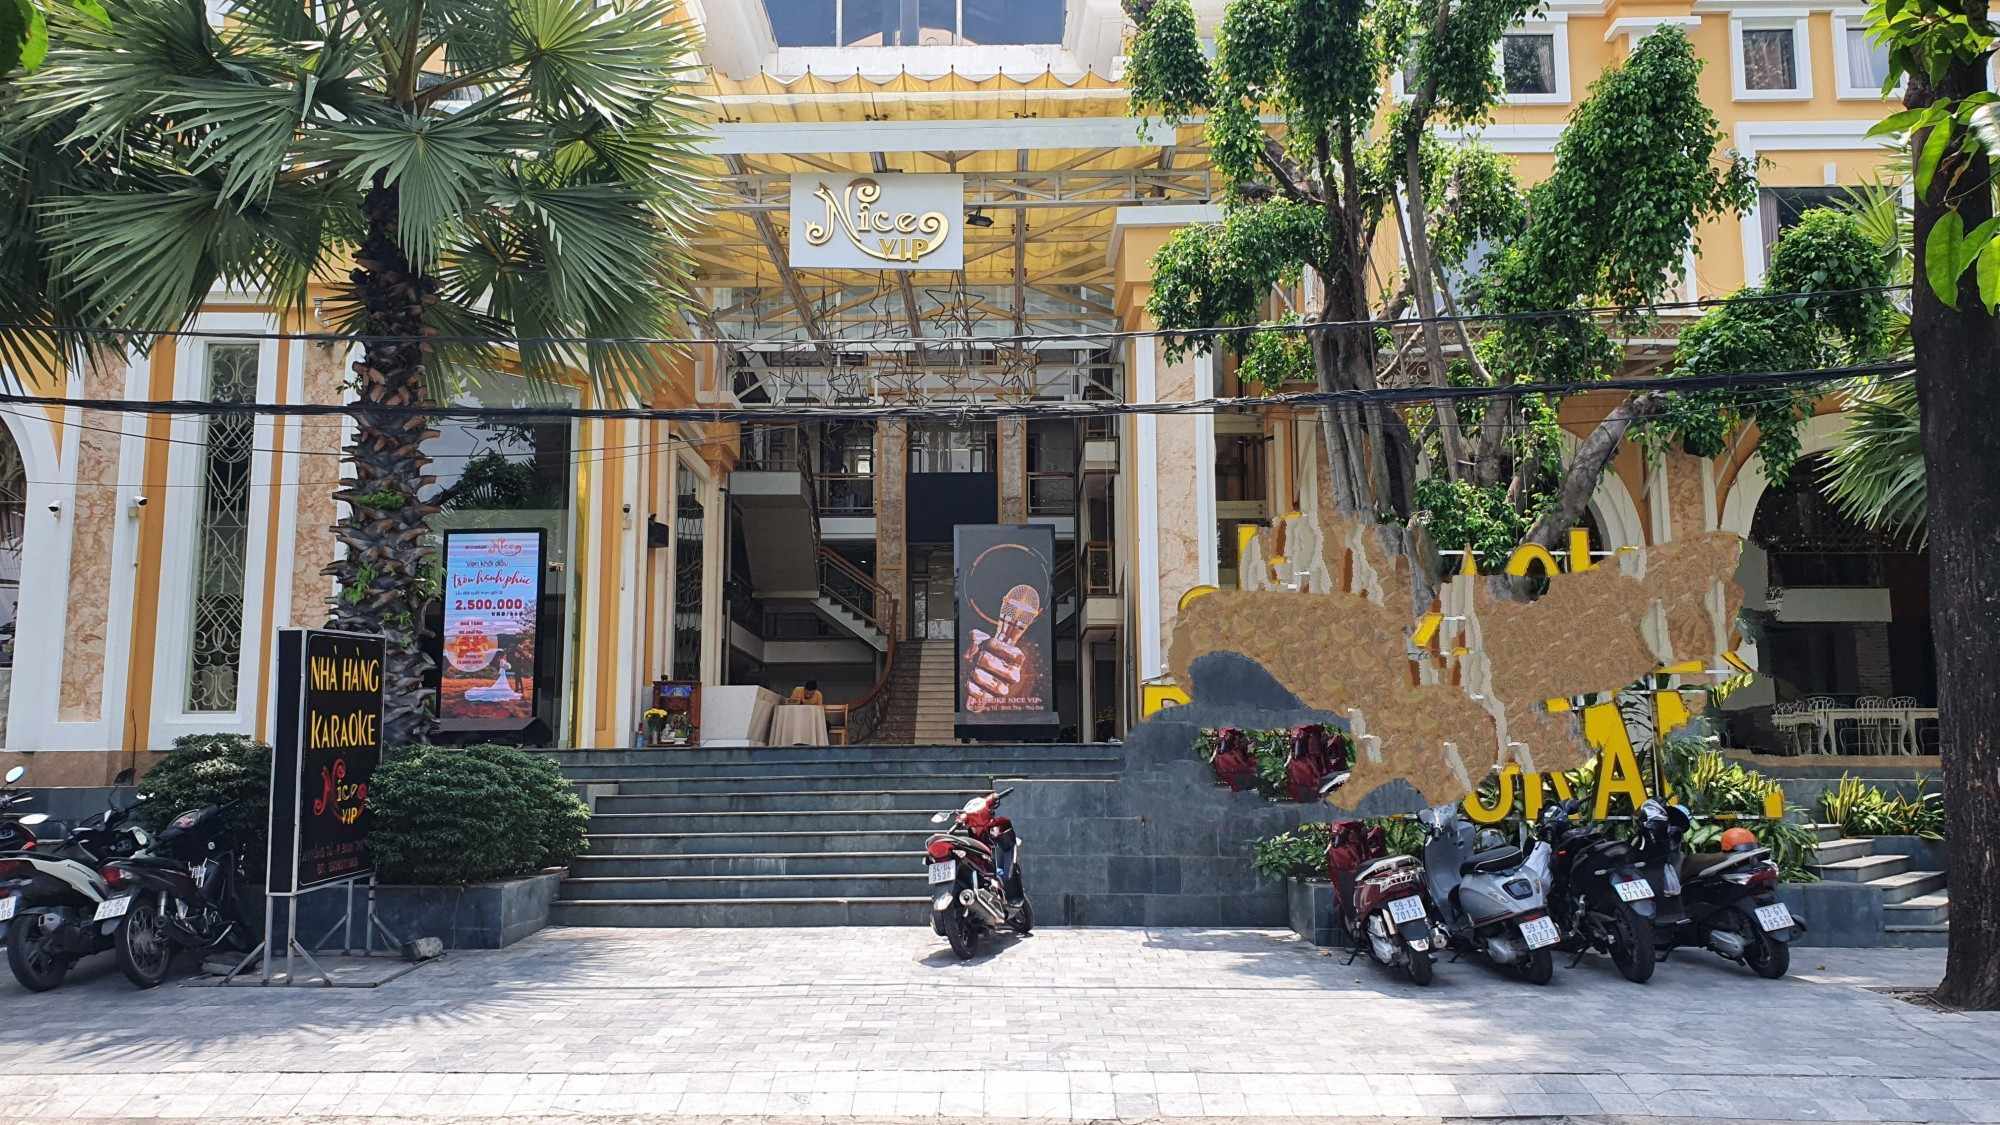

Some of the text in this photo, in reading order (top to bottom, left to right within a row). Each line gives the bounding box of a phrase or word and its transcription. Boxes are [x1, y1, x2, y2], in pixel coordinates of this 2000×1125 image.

[879, 238, 929, 262] VIP
[455, 599, 523, 610] 2.500.000
[310, 645, 380, 692] NHÀ HÀNG
[310, 709, 376, 749] KARAOKE
[342, 807, 358, 825] VIP
